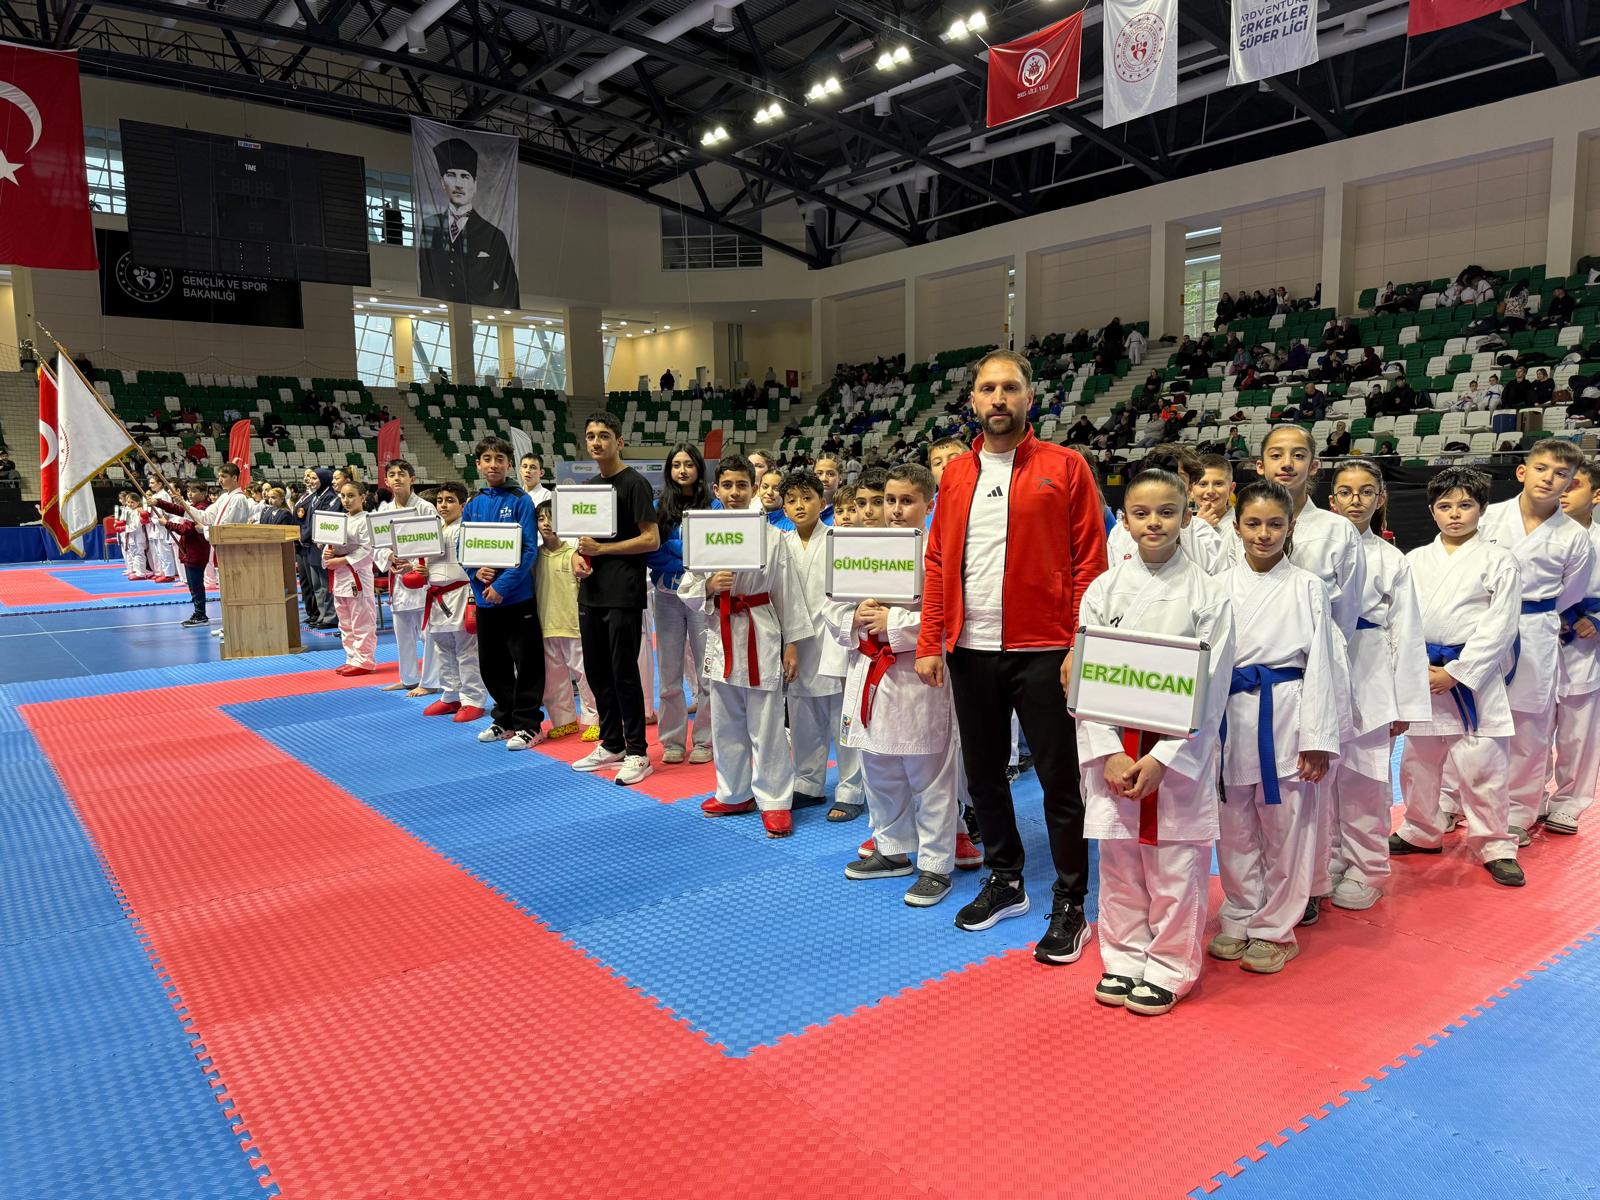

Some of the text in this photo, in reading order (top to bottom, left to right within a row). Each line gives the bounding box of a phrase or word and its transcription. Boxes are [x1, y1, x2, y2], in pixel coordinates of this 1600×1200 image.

[1240, 5, 1308, 37] ERKEKLER
[1239, 15, 1308, 51] SÜPER LİGİ
[244, 163, 257, 172] TIME
[182, 275, 225, 289] GENÇLİK
[226, 279, 240, 290] VE
[241, 281, 268, 292] SPOR
[183, 287, 236, 302] BAKANLIĞI
[571, 502, 597, 515] RİZE
[319, 522, 339, 531] SİNOP
[396, 532, 438, 544] ERZURUM
[465, 536, 514, 550] GİRESUN
[705, 531, 744, 546] KARS
[833, 558, 915, 573] GÜMÜŞHANE
[1081, 662, 1194, 697] ERZİNCAN
